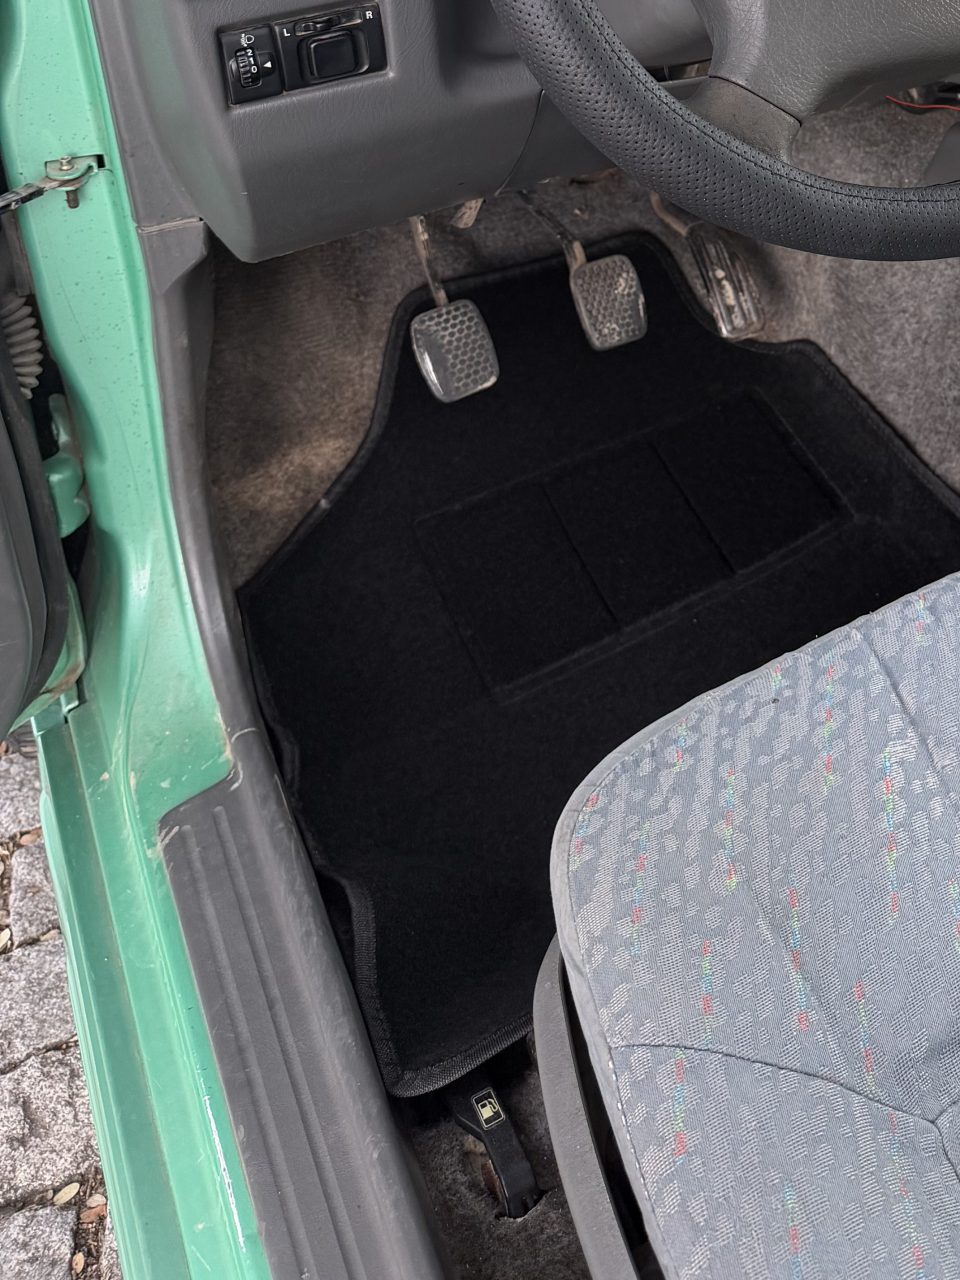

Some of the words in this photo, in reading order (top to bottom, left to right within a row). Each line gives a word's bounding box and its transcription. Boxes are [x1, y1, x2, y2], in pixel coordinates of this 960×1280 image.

[365, 10, 373, 19] R
[283, 28, 290, 37] L
[249, 57, 255, 65] 1
[251, 65, 258, 73] 0
